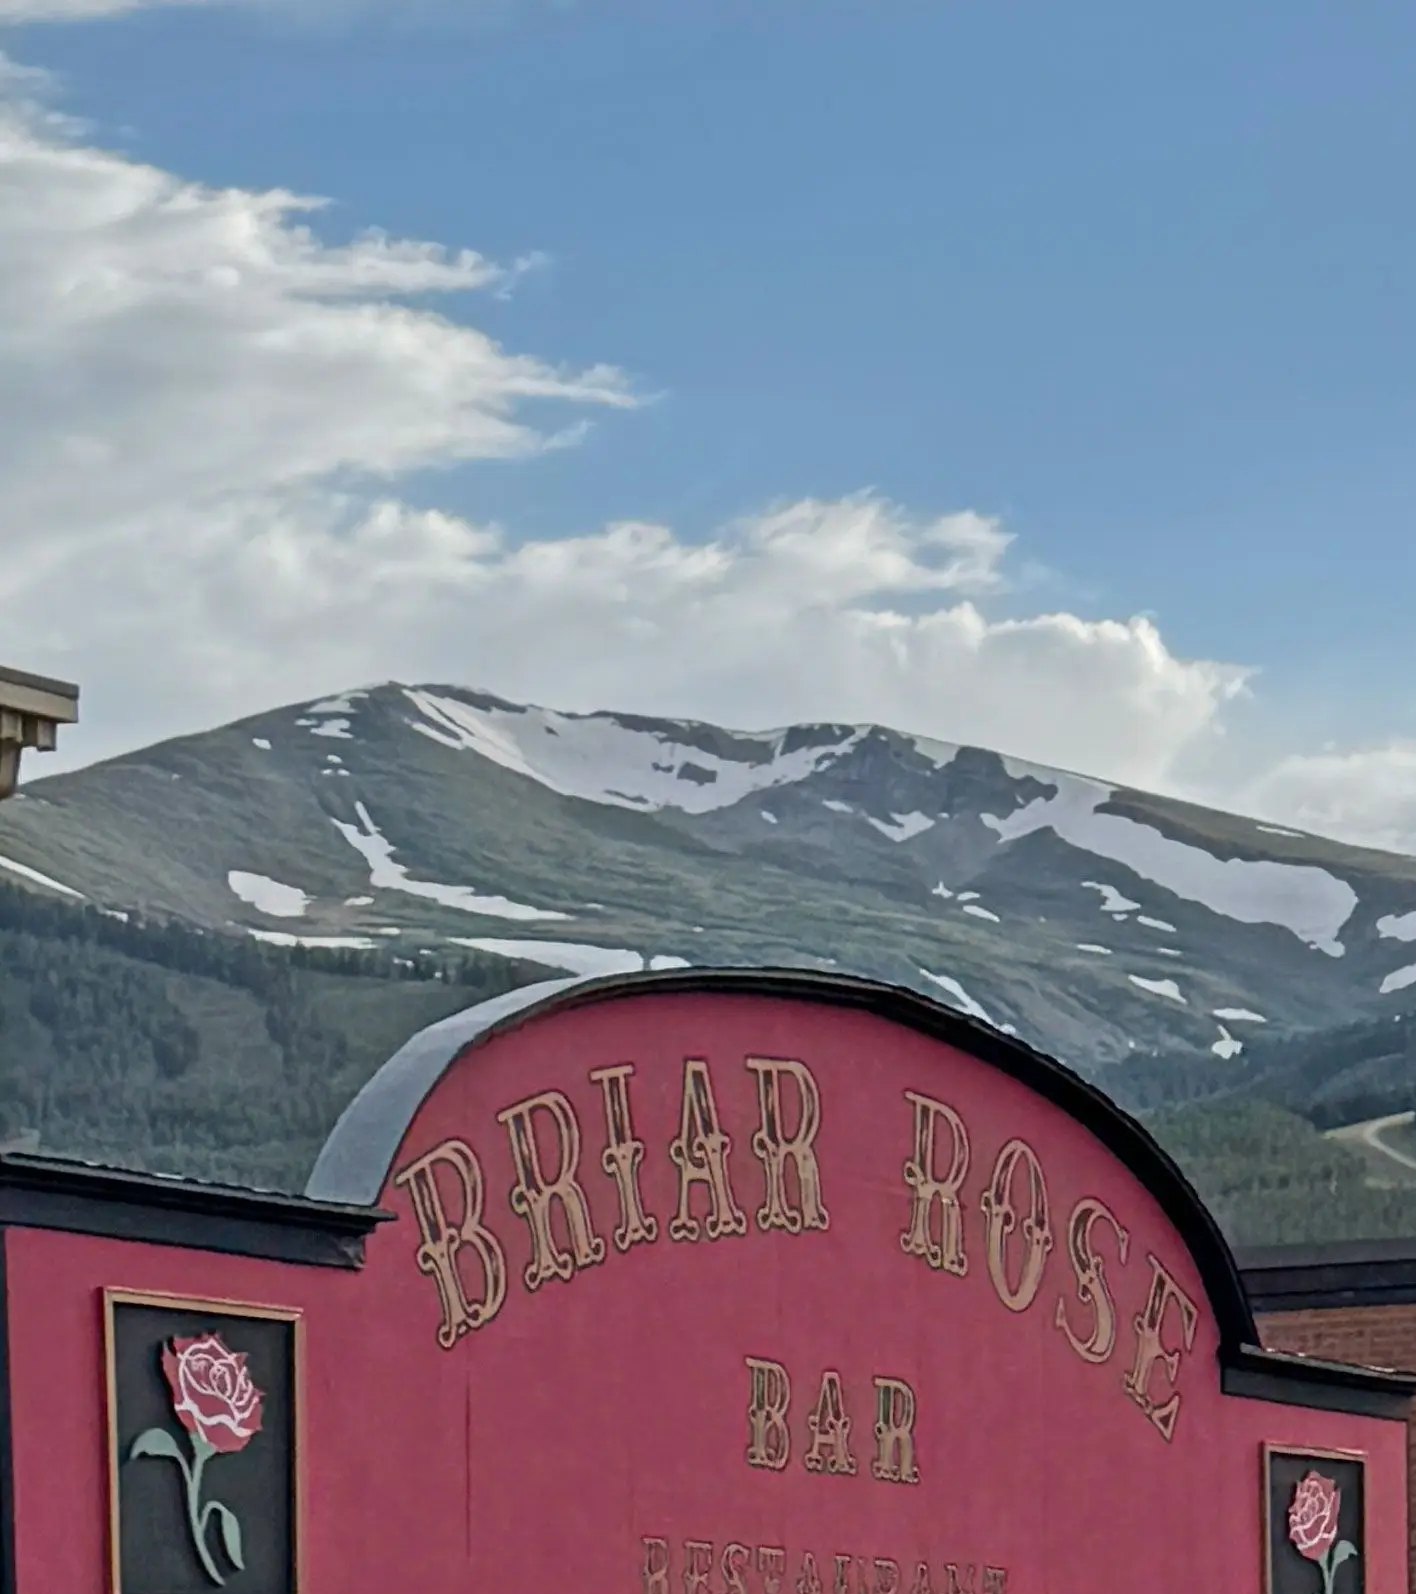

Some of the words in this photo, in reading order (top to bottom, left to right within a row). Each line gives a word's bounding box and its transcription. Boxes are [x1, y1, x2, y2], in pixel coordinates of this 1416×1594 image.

[396, 1057, 829, 1348] BRIAR
[901, 1090, 1198, 1441] ROSE
[745, 1357, 920, 1485] BAR
